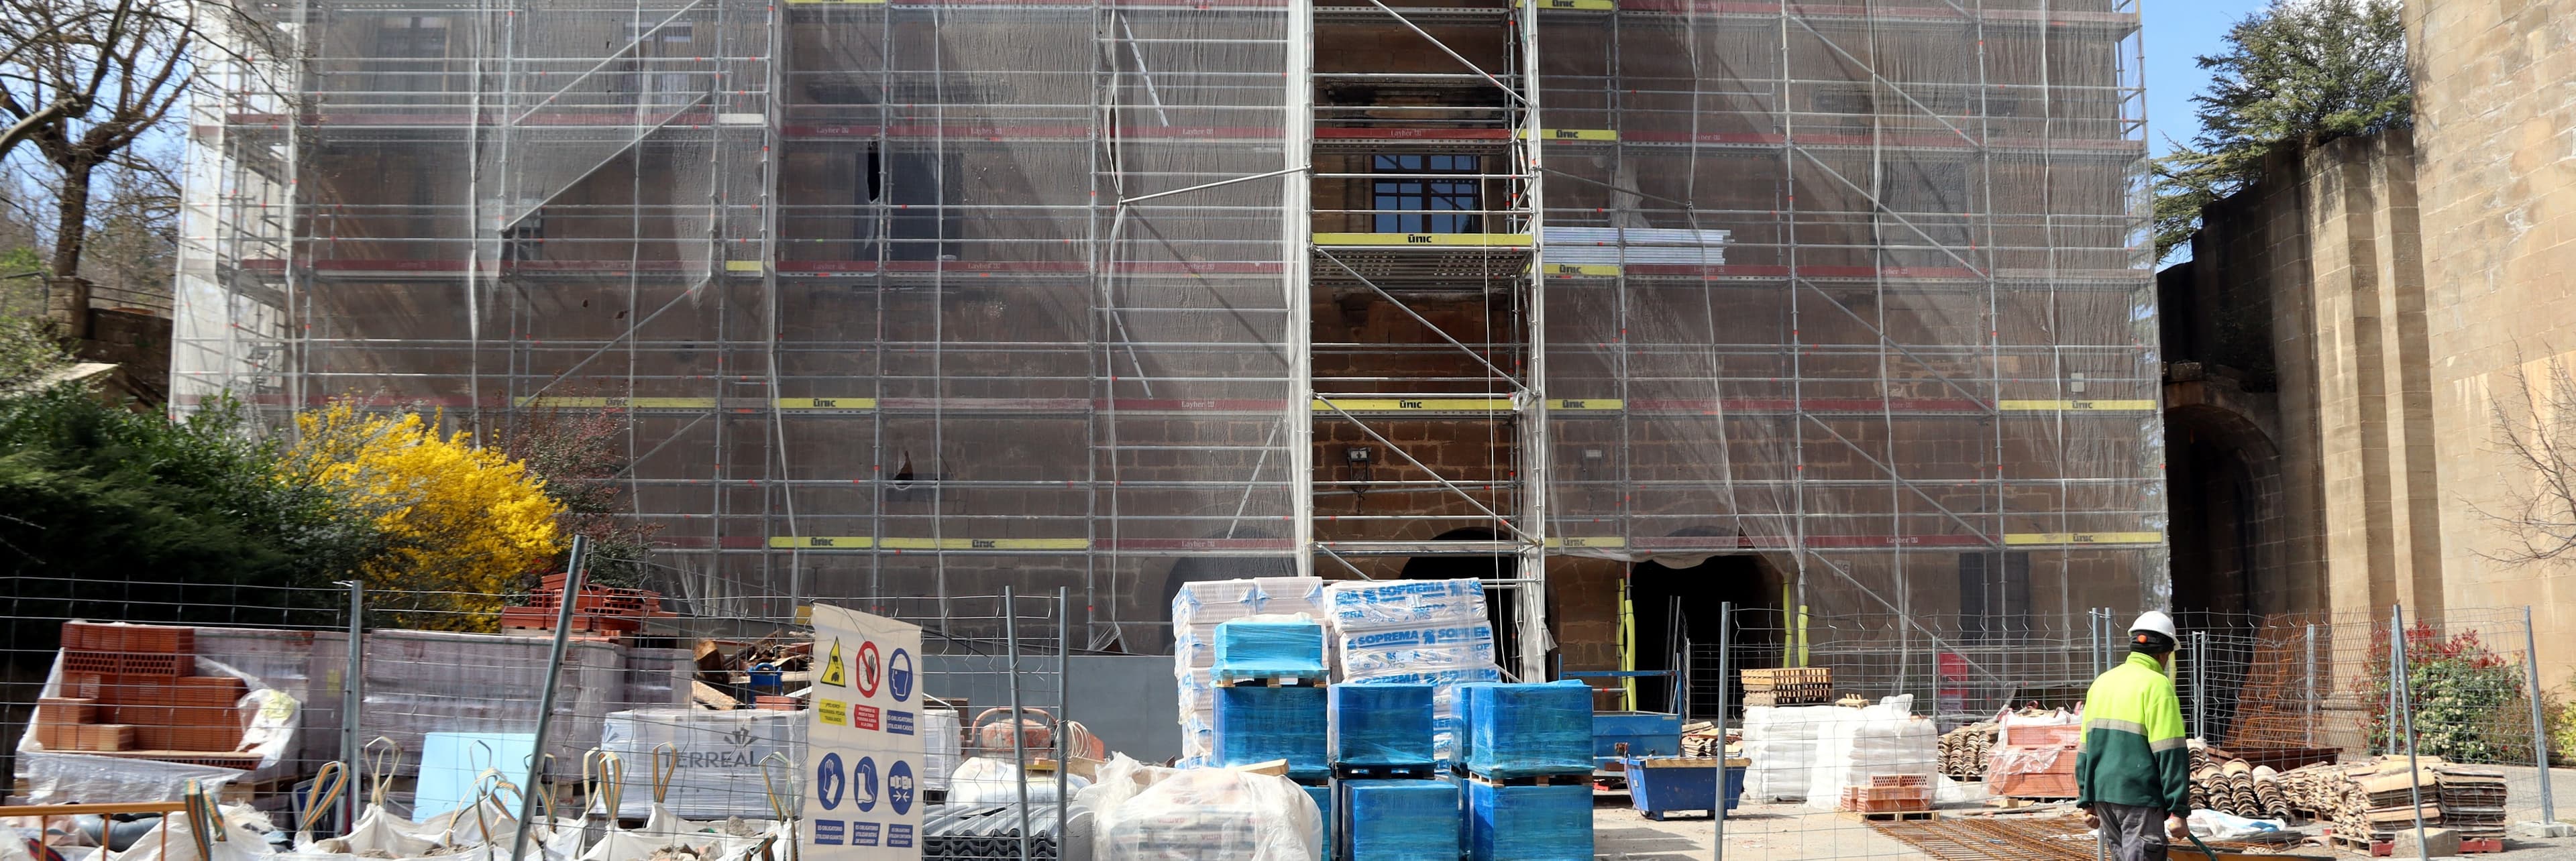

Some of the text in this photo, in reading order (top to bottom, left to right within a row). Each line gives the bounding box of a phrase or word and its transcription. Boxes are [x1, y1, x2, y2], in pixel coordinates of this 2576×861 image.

[1181, 400, 1204, 409] Layher
[1379, 582, 1445, 597] SOPREMA
[1413, 612, 1432, 621] XPS
[1358, 630, 1419, 645] SOPREMA
[661, 750, 757, 768] TERREAL
